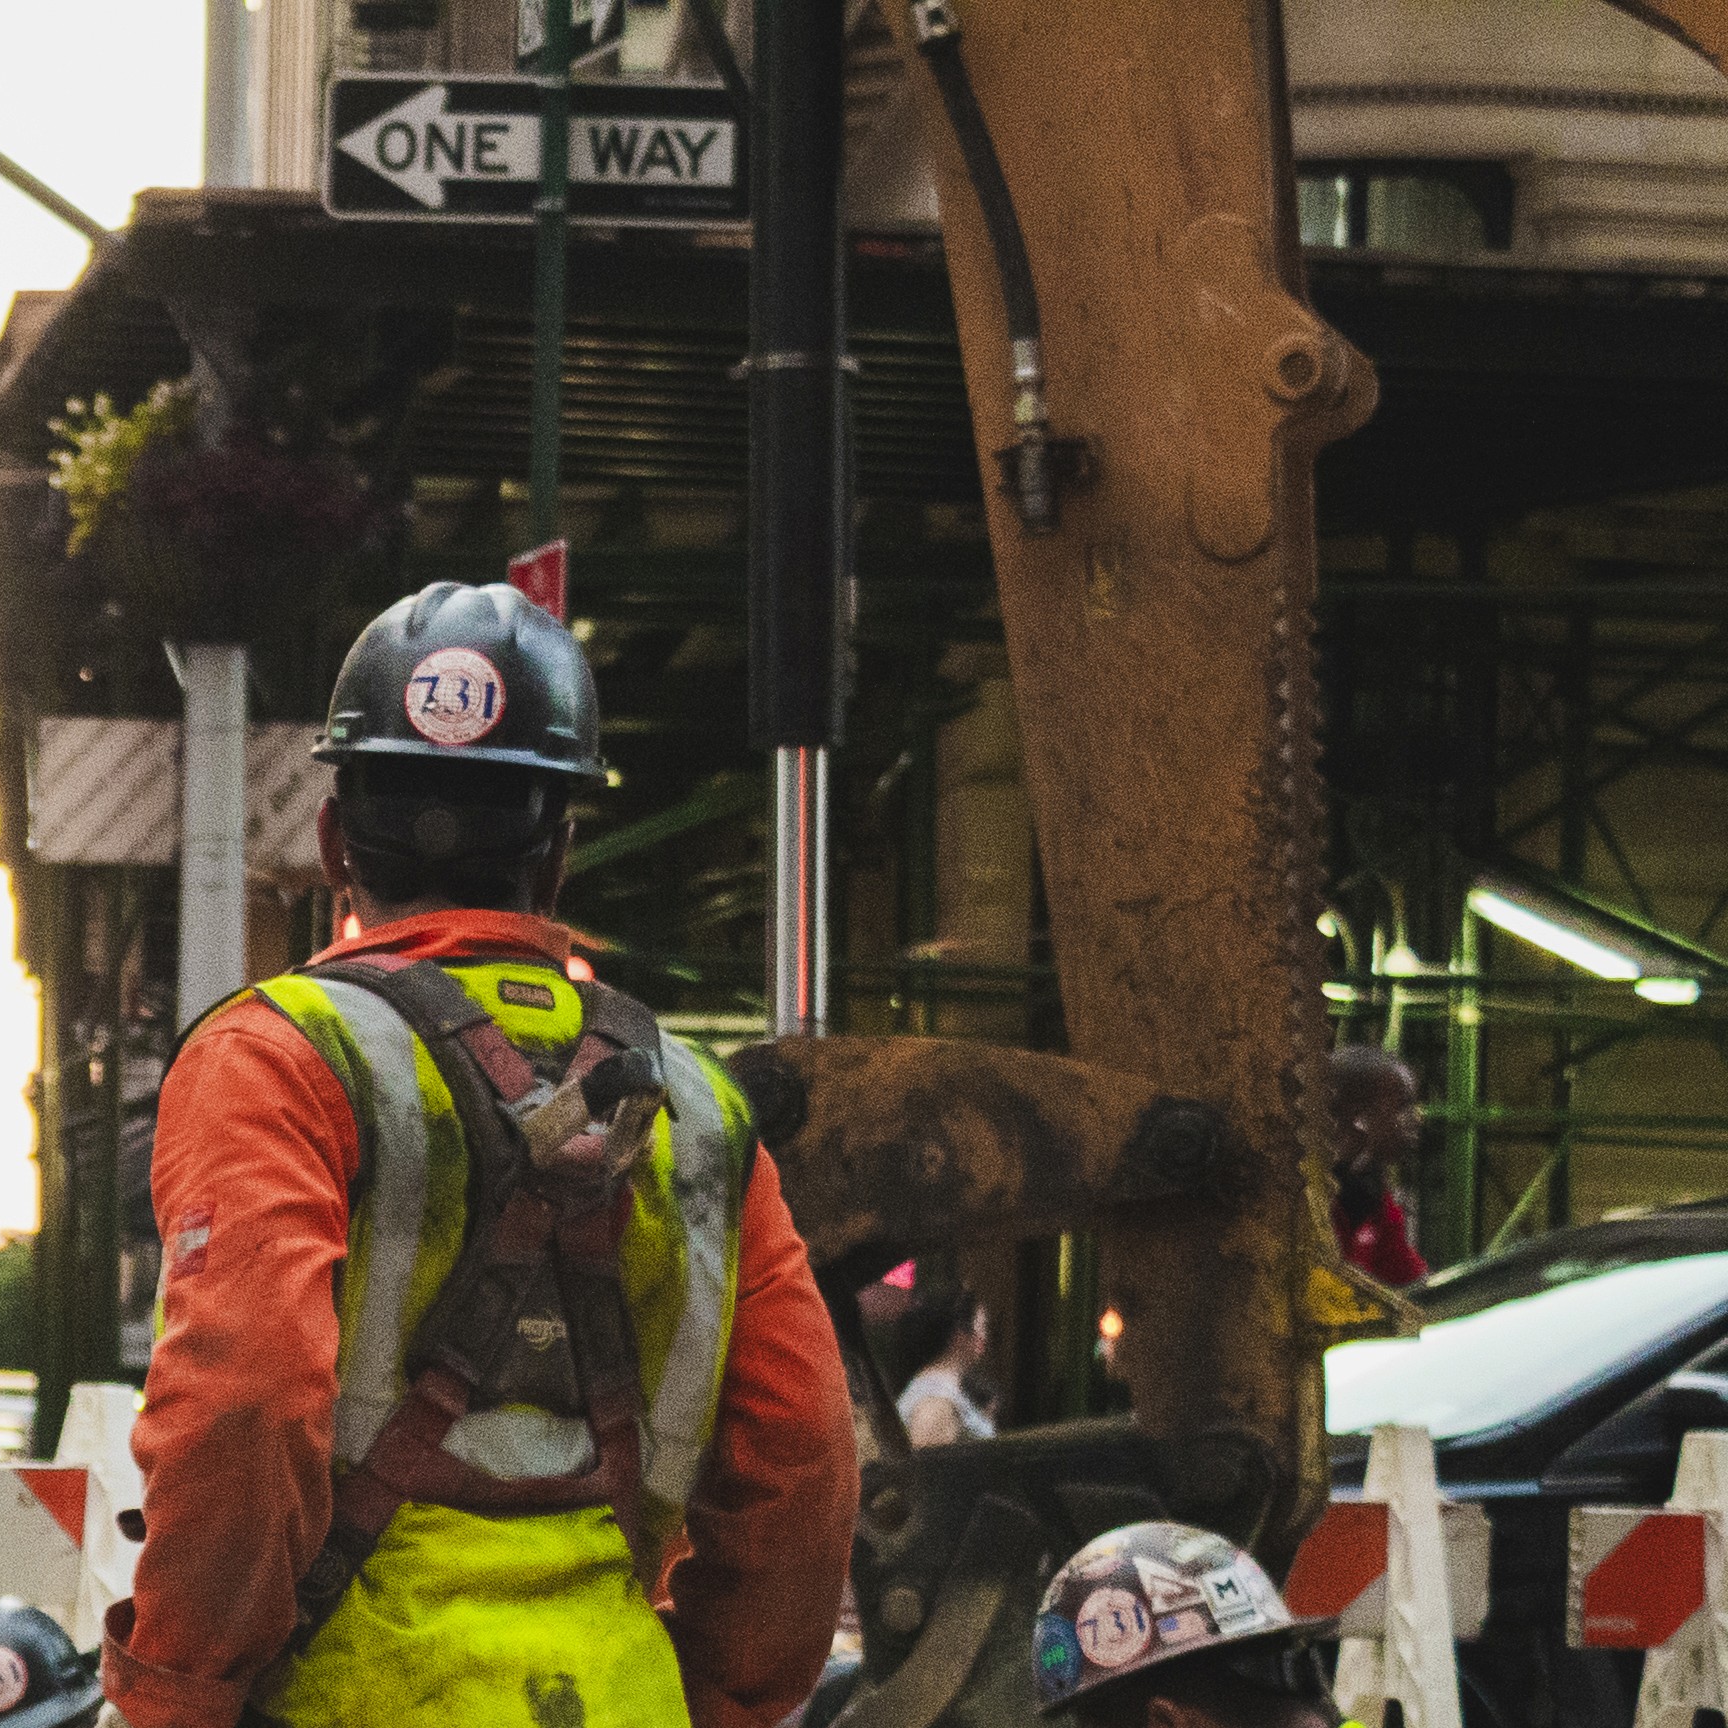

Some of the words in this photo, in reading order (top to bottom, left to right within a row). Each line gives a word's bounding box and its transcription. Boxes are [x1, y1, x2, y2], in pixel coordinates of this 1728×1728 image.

[374, 120, 511, 176] ONE
[586, 124, 718, 177] WAY
[412, 674, 496, 720] 731
